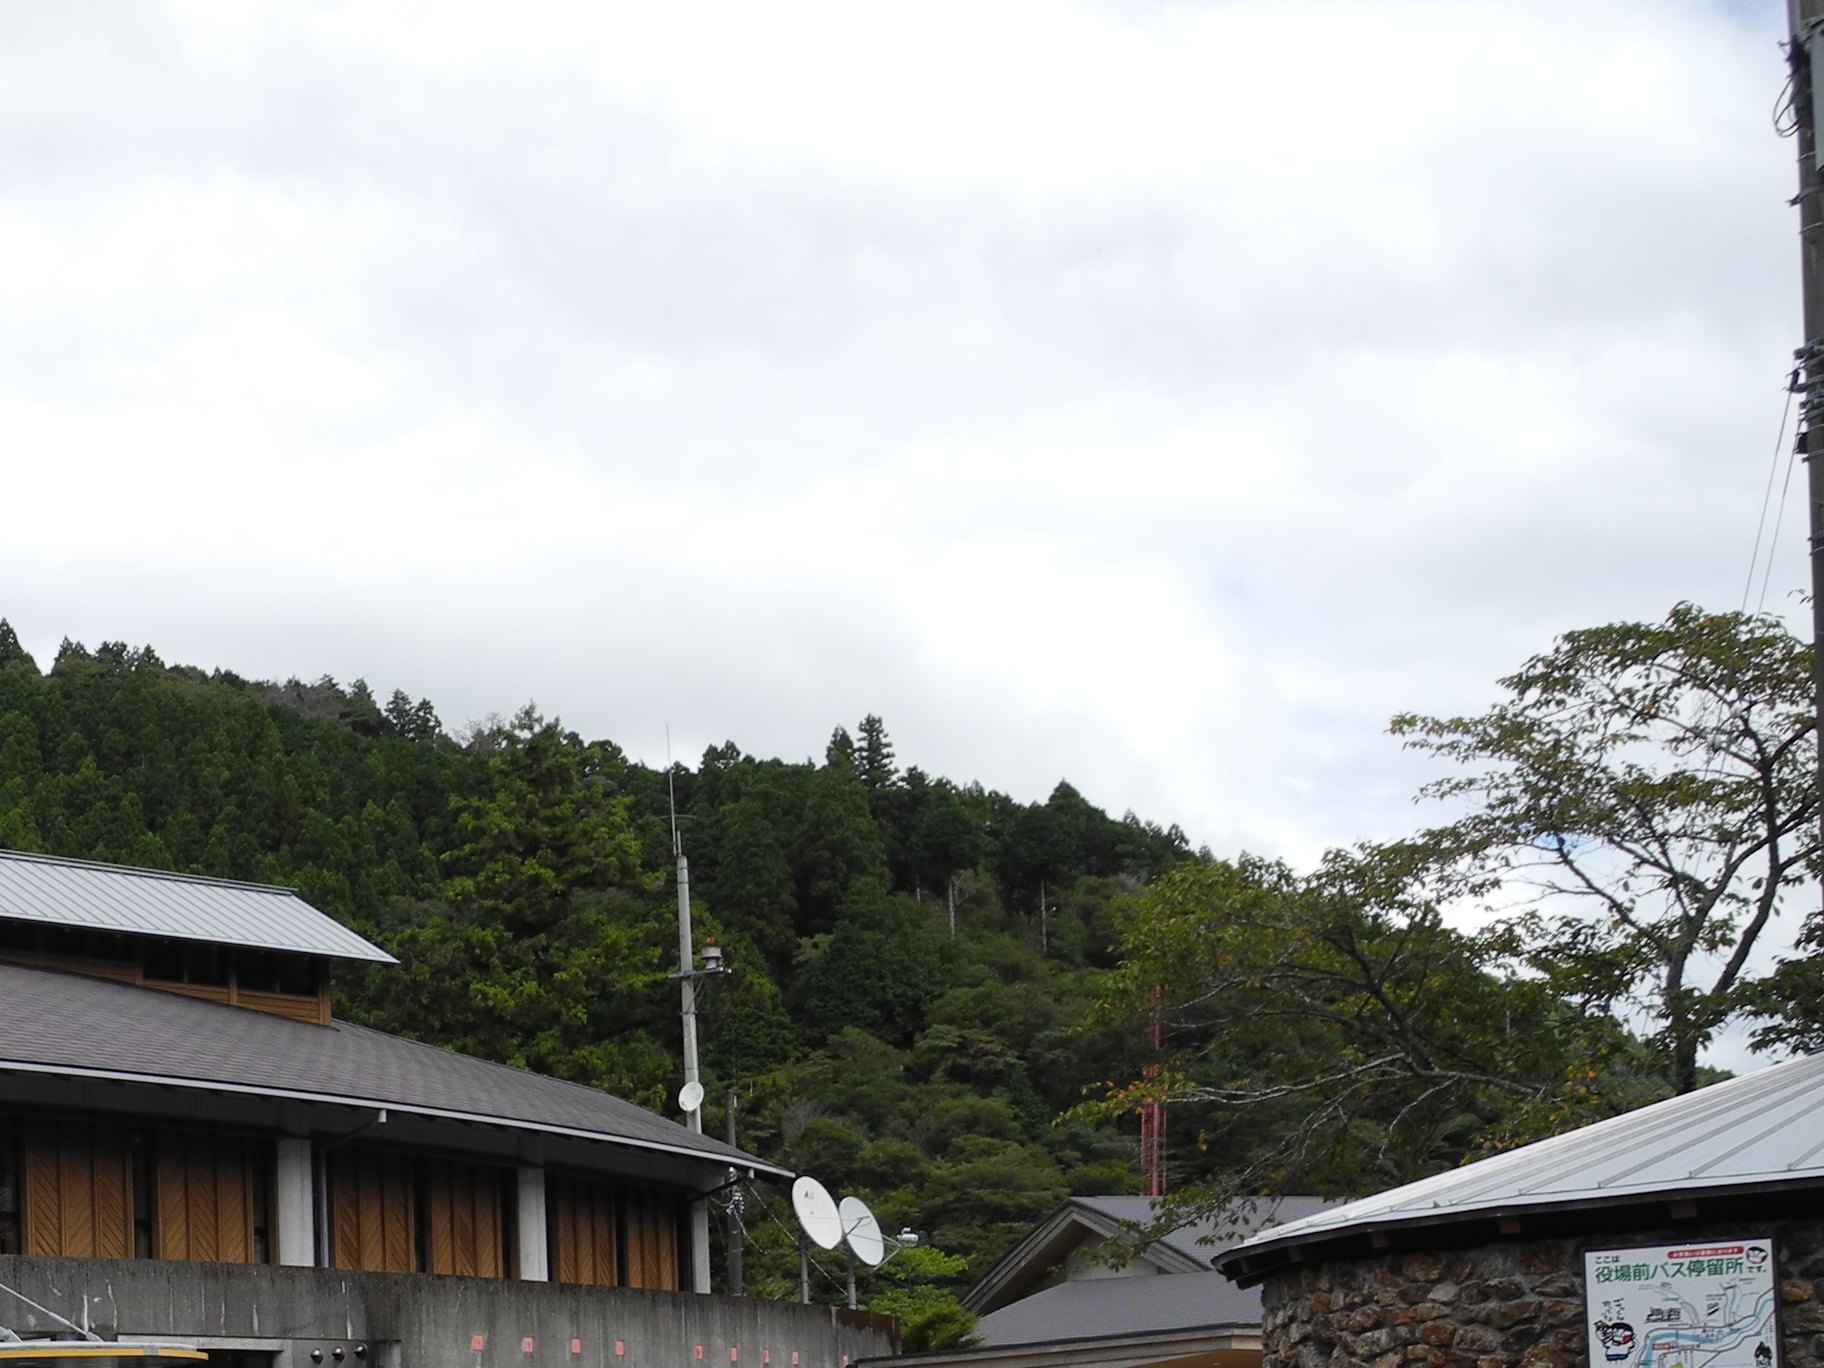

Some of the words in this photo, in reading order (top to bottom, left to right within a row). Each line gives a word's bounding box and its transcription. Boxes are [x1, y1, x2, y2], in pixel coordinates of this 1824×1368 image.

[1594, 1255, 1621, 1264] ここは
[1595, 1256, 1744, 1284] 役場前バス停留所
